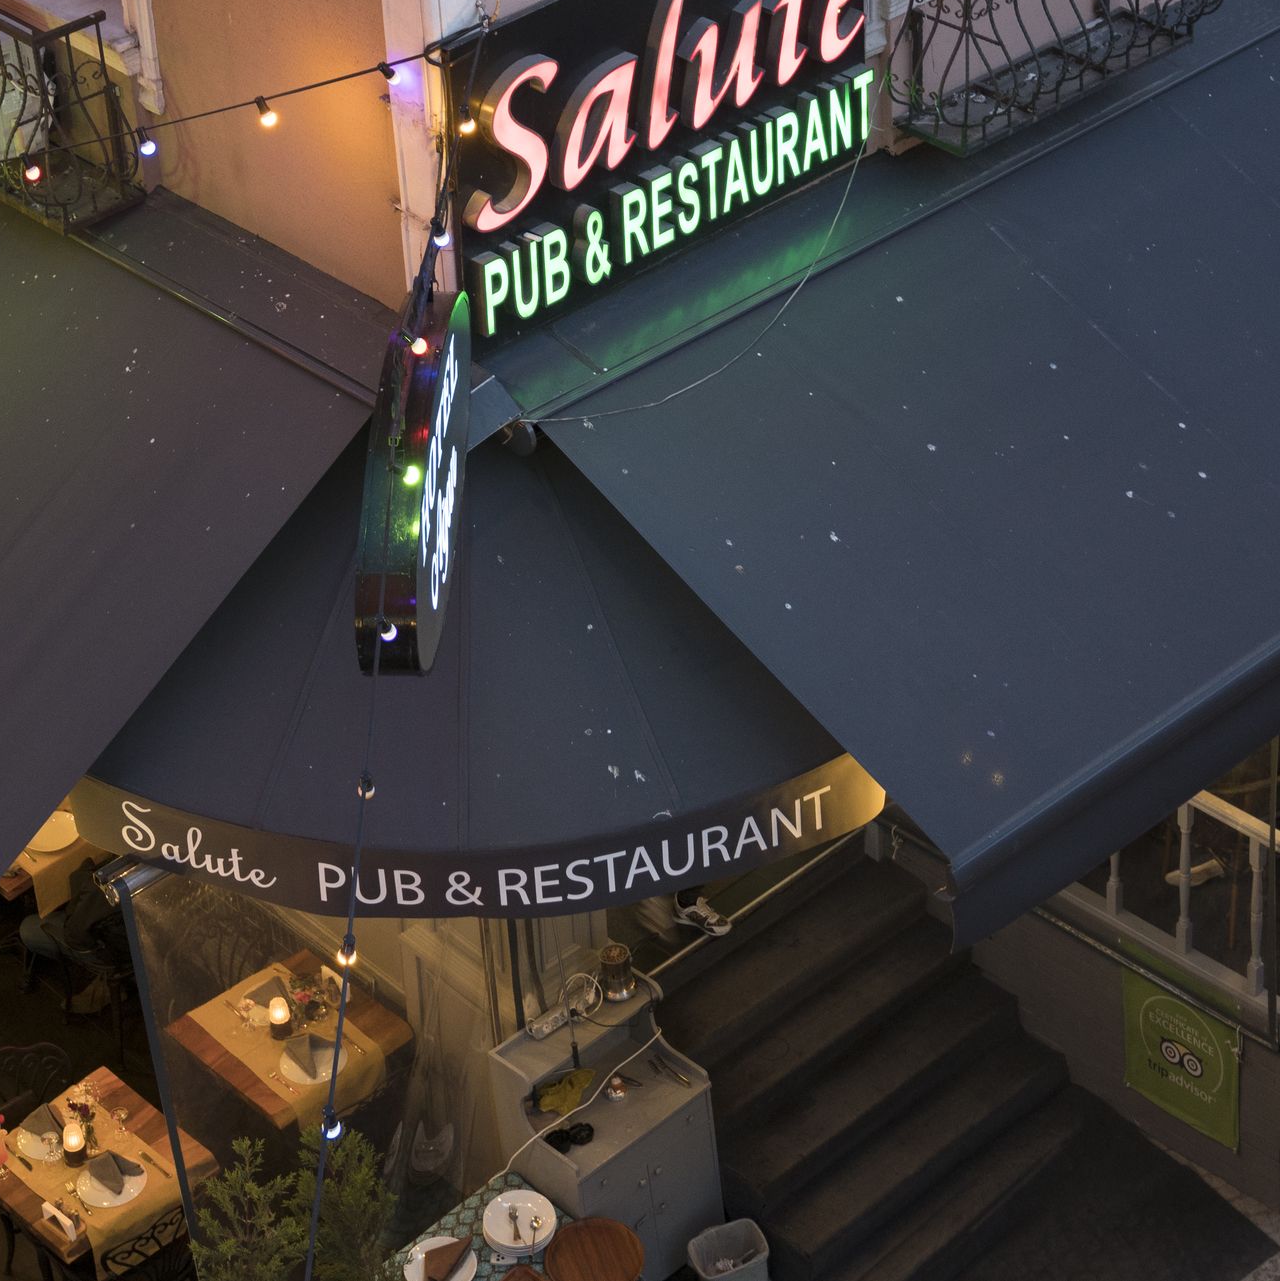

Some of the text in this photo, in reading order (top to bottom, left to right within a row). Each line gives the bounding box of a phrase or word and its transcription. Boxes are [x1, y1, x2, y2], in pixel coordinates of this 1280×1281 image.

[482, 68, 875, 337] PUB & RESTAURANT
[422, 333, 459, 568] HOTEL
[120, 785, 833, 907] Salute PUB & RESTAURANT
[1147, 1058, 1214, 1105] tripadvisor
[1149, 1011, 1214, 1057] EXCELLENCE
